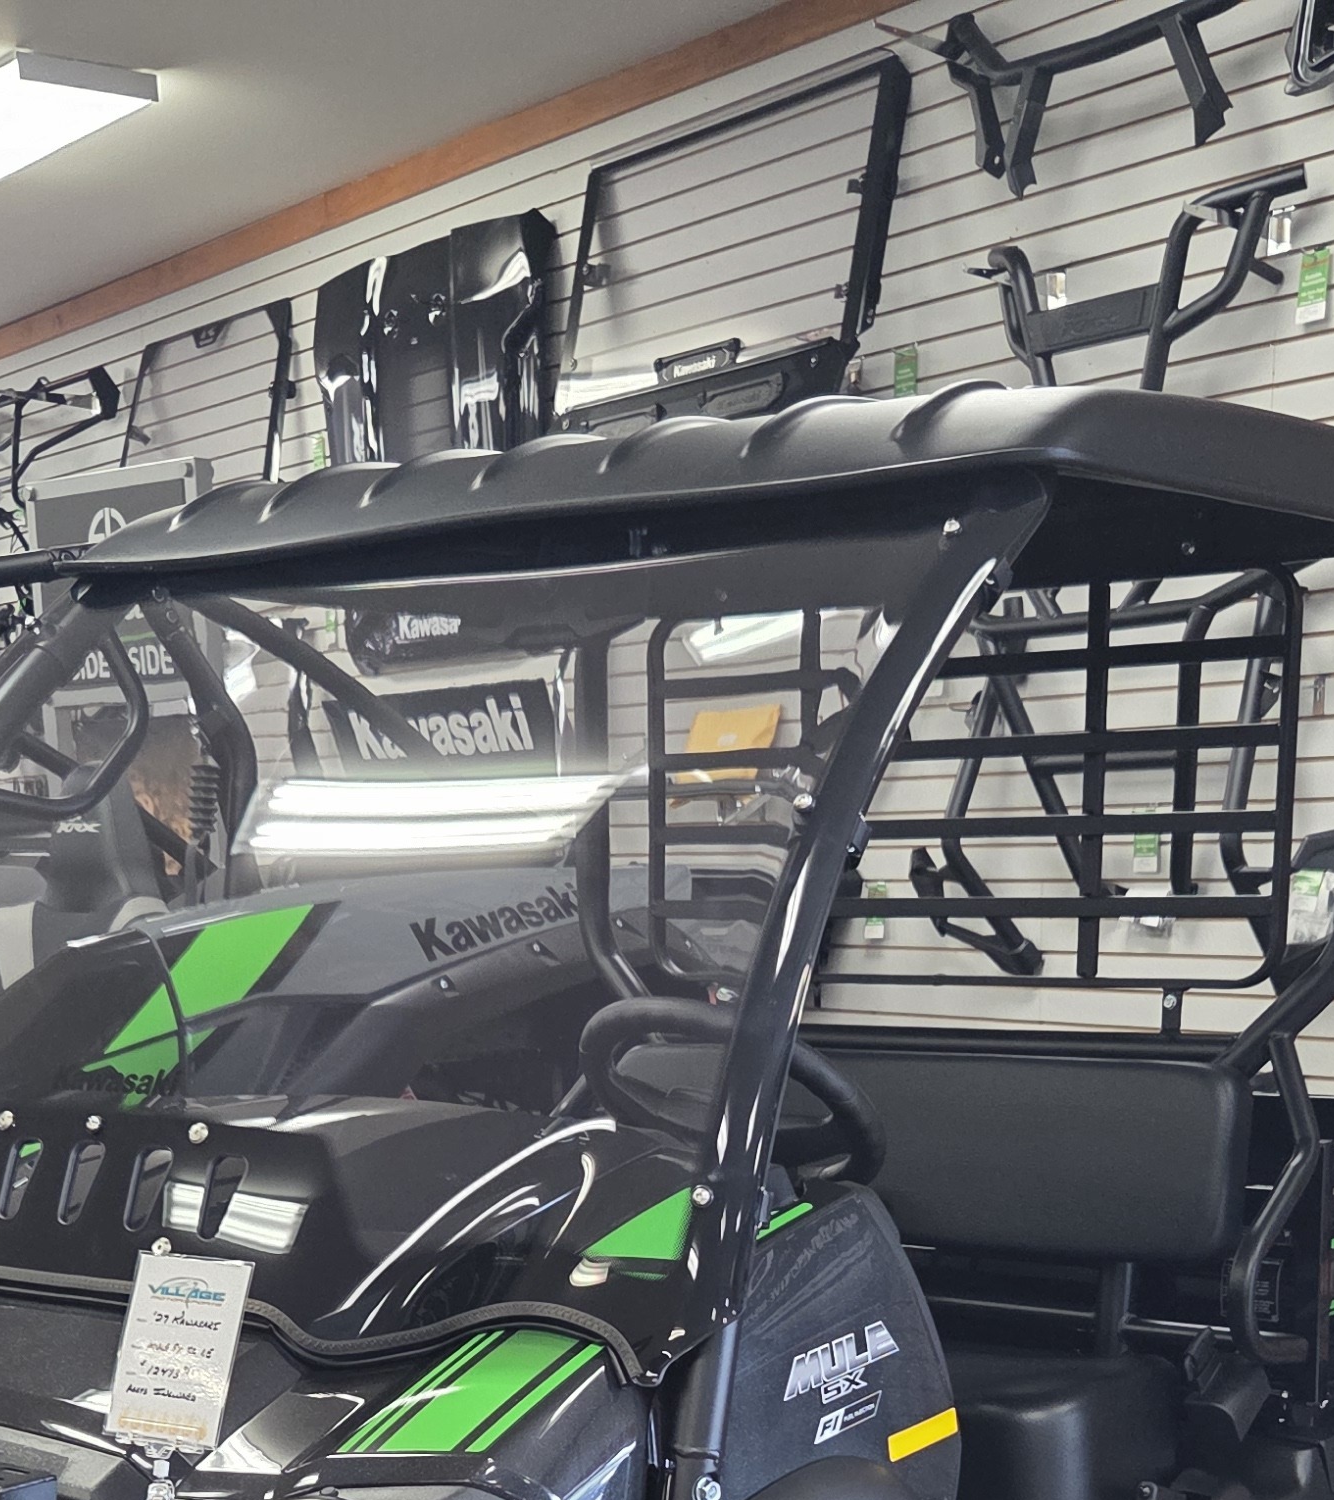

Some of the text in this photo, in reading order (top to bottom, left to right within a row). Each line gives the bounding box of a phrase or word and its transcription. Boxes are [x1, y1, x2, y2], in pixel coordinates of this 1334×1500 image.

[128, 644, 175, 675] SIDE
[148, 1283, 226, 1303] VILLAGE
[783, 1320, 900, 1402] MULE
